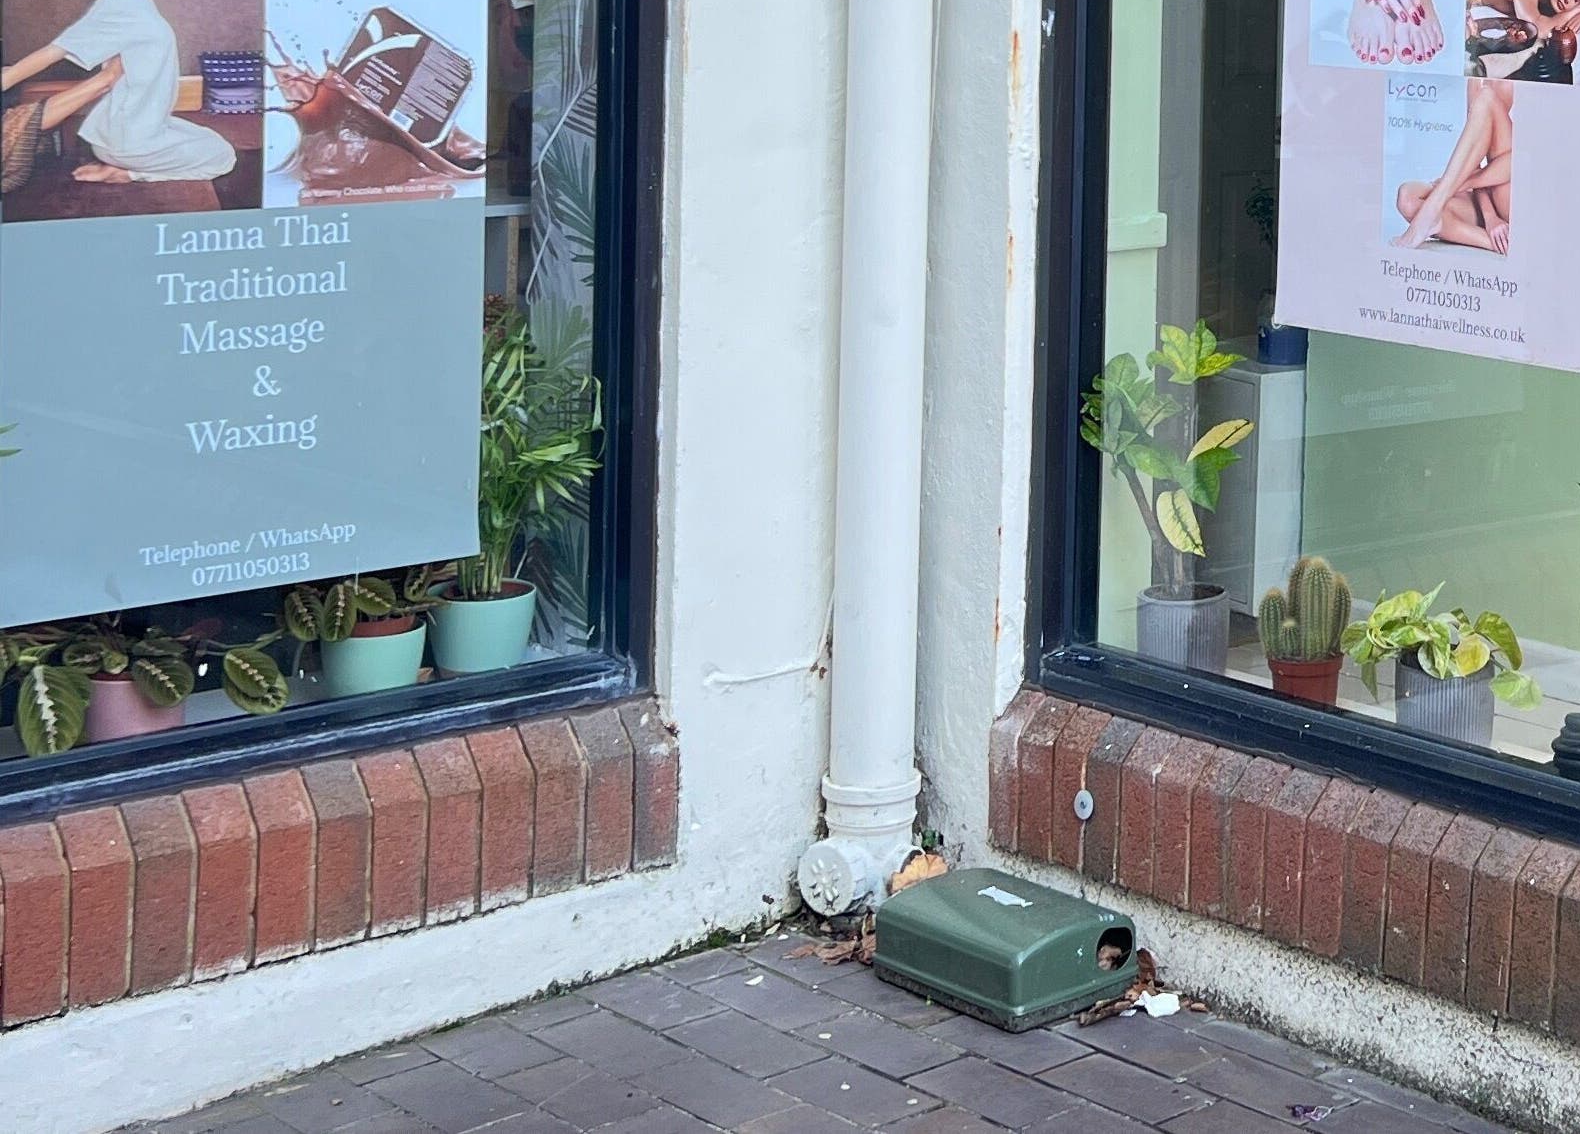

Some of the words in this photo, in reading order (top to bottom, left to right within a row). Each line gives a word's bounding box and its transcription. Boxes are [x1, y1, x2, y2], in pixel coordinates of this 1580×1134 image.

[1388, 78, 1437, 98] Lycon
[155, 223, 264, 257] Lanna
[274, 212, 351, 248] Thai
[157, 262, 347, 306] Traditional
[1381, 260, 1441, 283] Telephone
[1443, 270, 1450, 284] /
[1454, 270, 1518, 297] WhatsApp
[1406, 286, 1481, 312] 07711050313
[180, 317, 325, 355] Massage
[1360, 307, 1526, 343] www.lannathaiwellness.co.uk
[253, 365, 282, 396] &
[186, 413, 318, 455] Waxing
[139, 538, 241, 568] Telephone
[244, 533, 257, 554] /
[259, 521, 357, 551] WhatsApp
[192, 553, 311, 587] 07711050313
